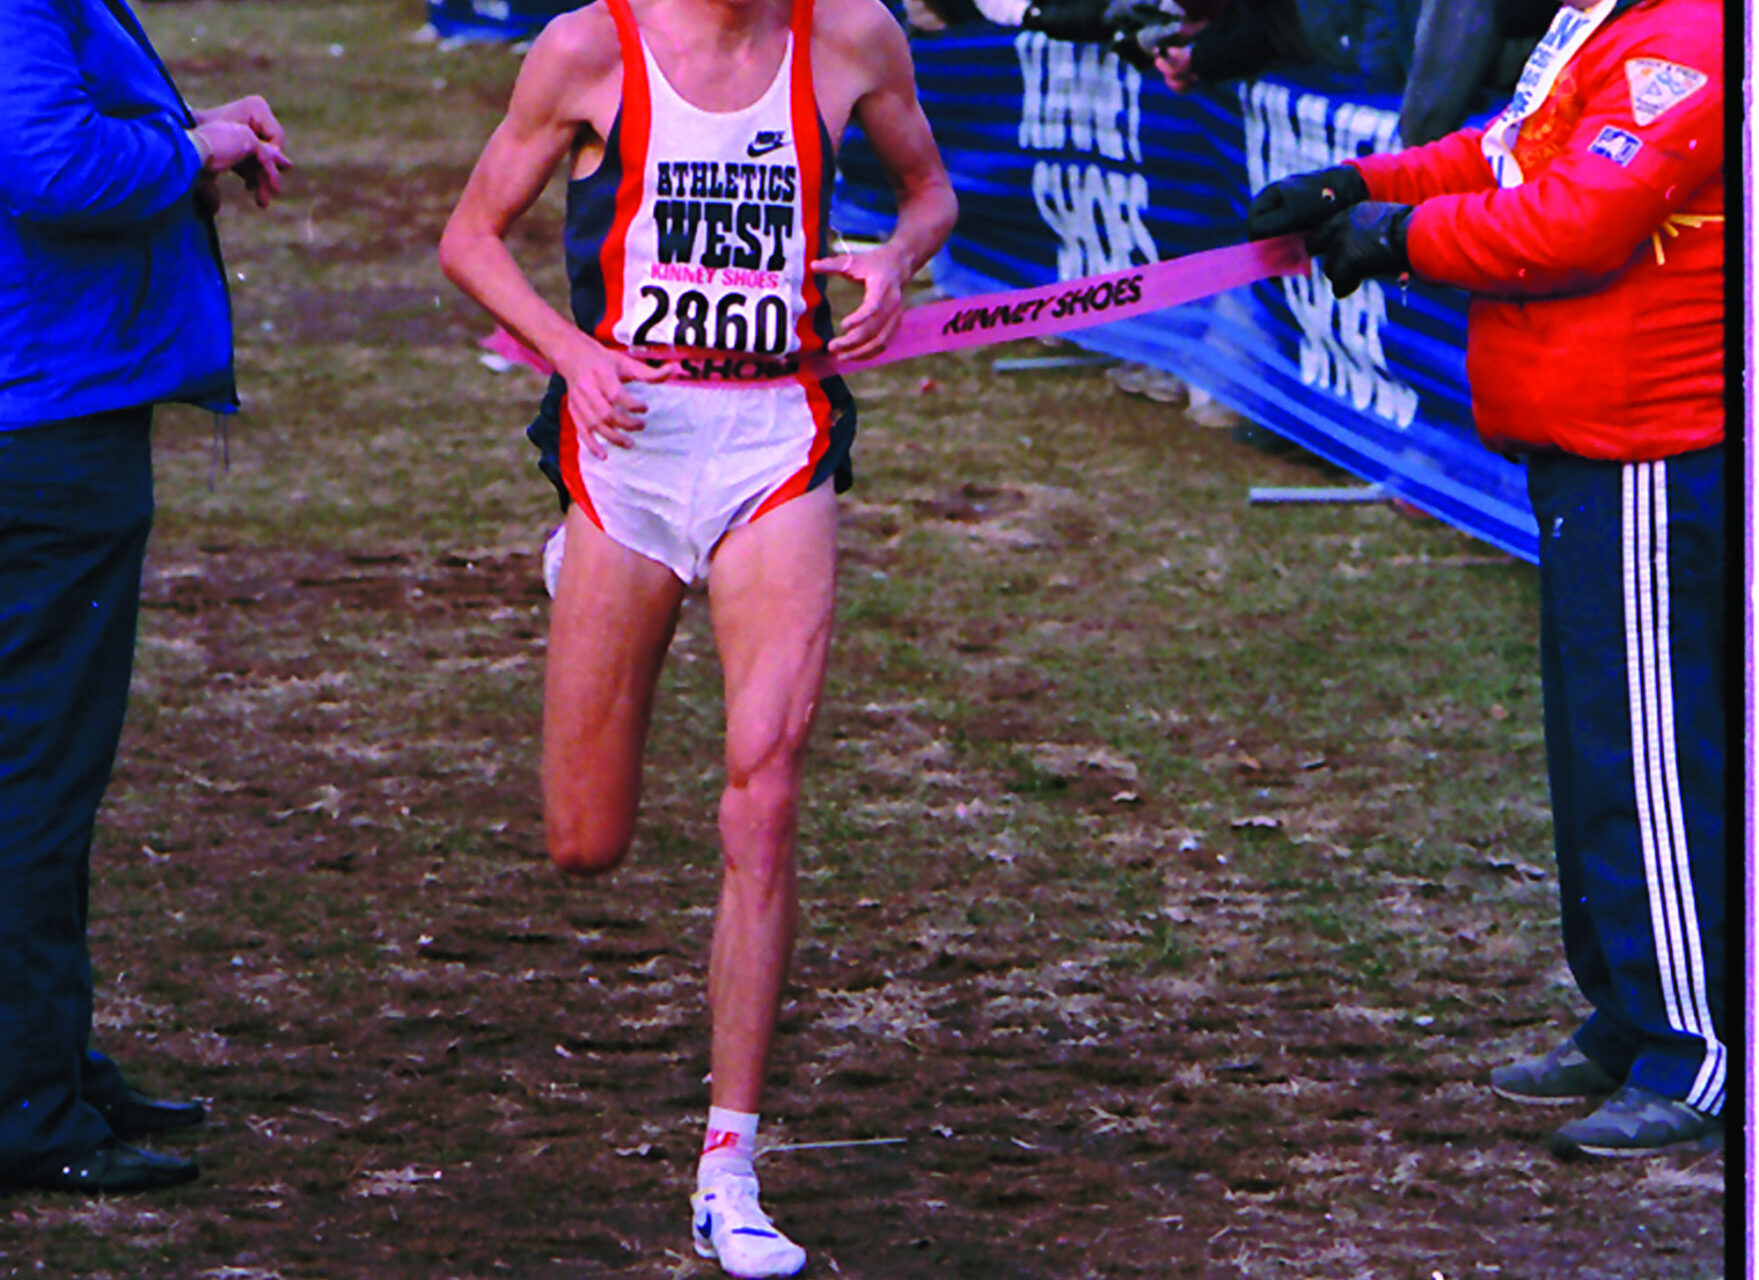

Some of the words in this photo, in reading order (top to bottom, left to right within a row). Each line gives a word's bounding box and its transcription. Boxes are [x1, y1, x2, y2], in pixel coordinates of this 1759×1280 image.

[657, 162, 796, 202] ATHLETICS
[653, 200, 794, 272] WEST
[650, 263, 716, 283] KINNEY
[721, 269, 779, 290] SHOES
[942, 295, 1056, 336] KINNEY
[1051, 274, 1144, 319] SHOES
[632, 285, 788, 355] 2860
